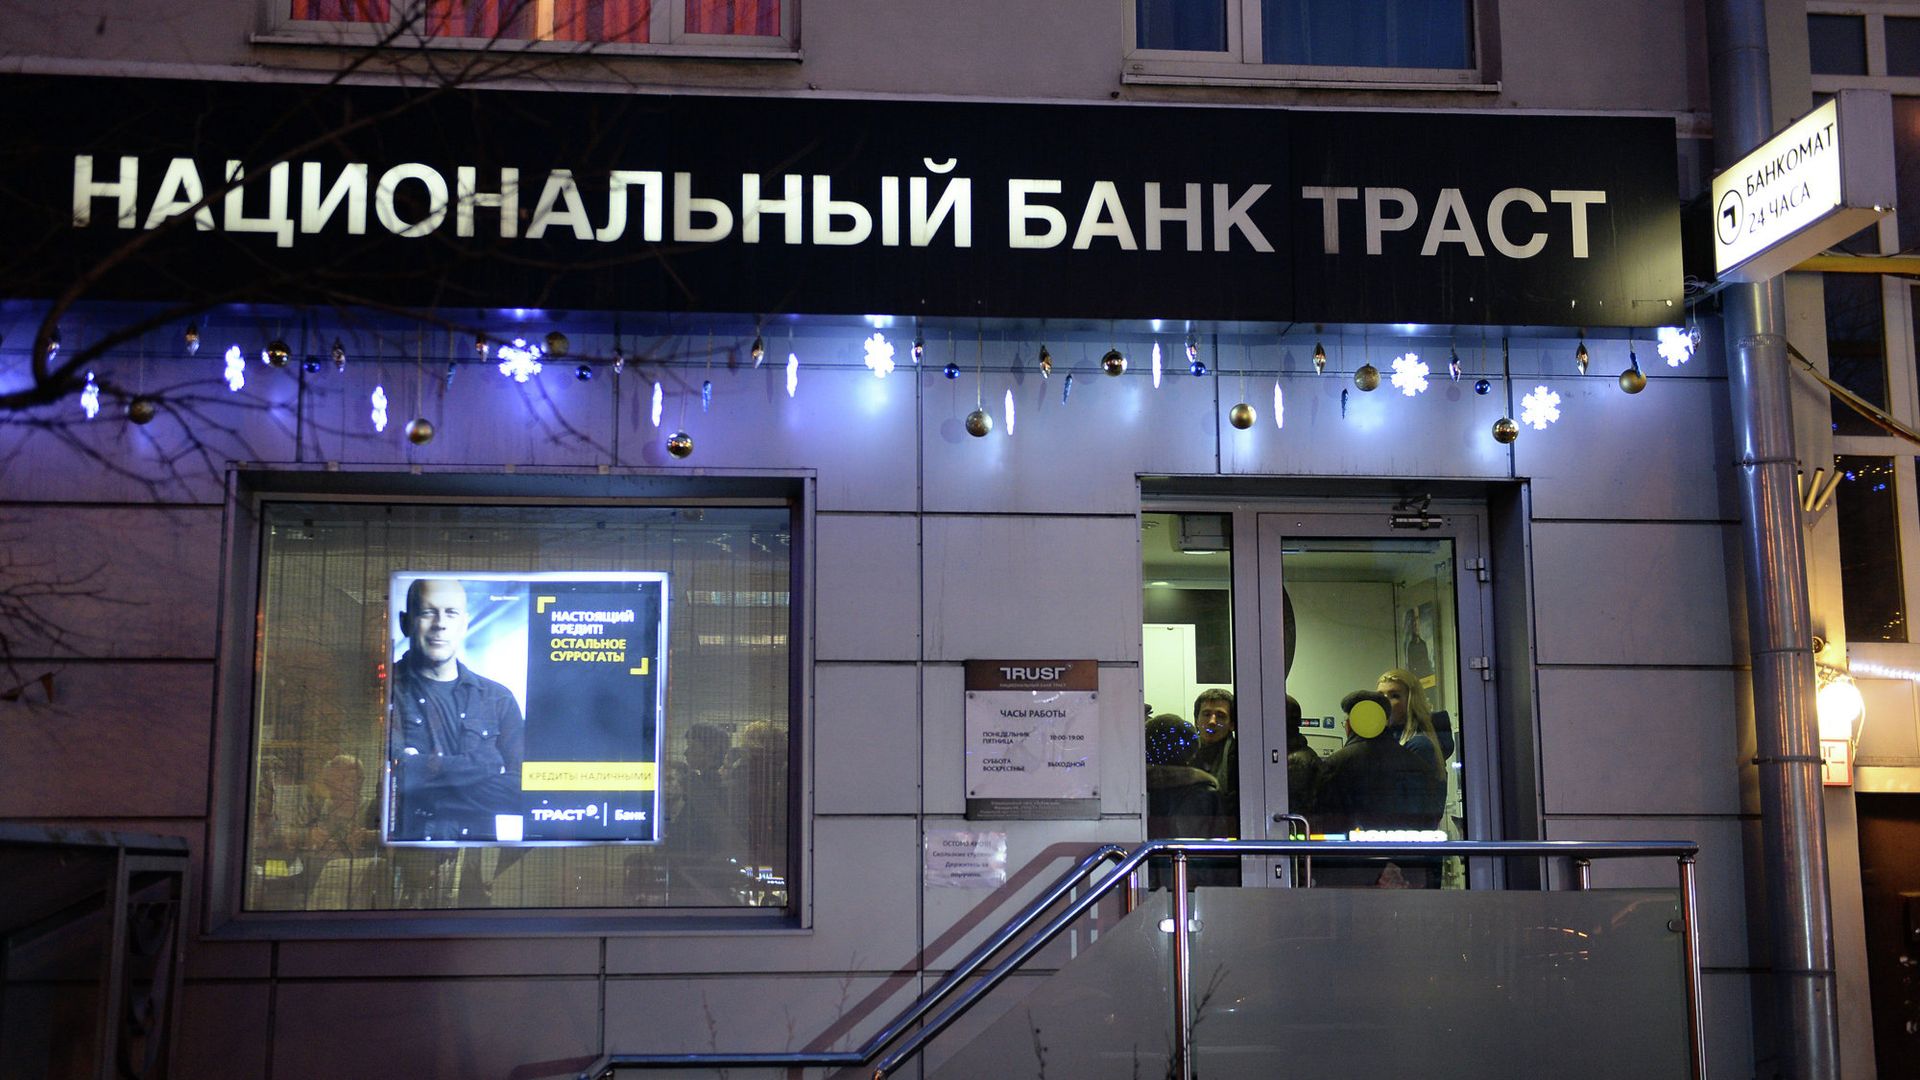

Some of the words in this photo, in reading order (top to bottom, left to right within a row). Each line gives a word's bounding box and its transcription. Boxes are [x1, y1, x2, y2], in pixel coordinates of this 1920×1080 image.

[1746, 122, 1834, 197] БАНКОМАТ
[74, 154, 972, 248] НАЦИОНАЛЬНЫЙ
[1008, 178, 1275, 253] БАНК
[1302, 186, 1607, 260] ТРАСТ
[1749, 207, 1765, 234] 24
[1769, 181, 1811, 219] ЧАСА
[551, 609, 635, 624] НАСТОЯЩИЙ
[550, 624, 604, 636] КРЕДИТ!
[550, 638, 627, 650] ОСТАЛЬНОЕ
[550, 651, 625, 662] СУРРОГАТЫ
[999, 667, 1066, 680] TRUST
[1000, 709, 1027, 718] ЧАСЫ
[1029, 709, 1066, 718] РАБОТЫ
[1047, 760, 1086, 768] ВЫХОДНОЙ
[529, 772, 577, 781] КРЕДИТЫ
[580, 772, 652, 781] НАЛИЧНЫМИ
[530, 808, 586, 821] ТРАСТ
[614, 809, 646, 821] Банк
